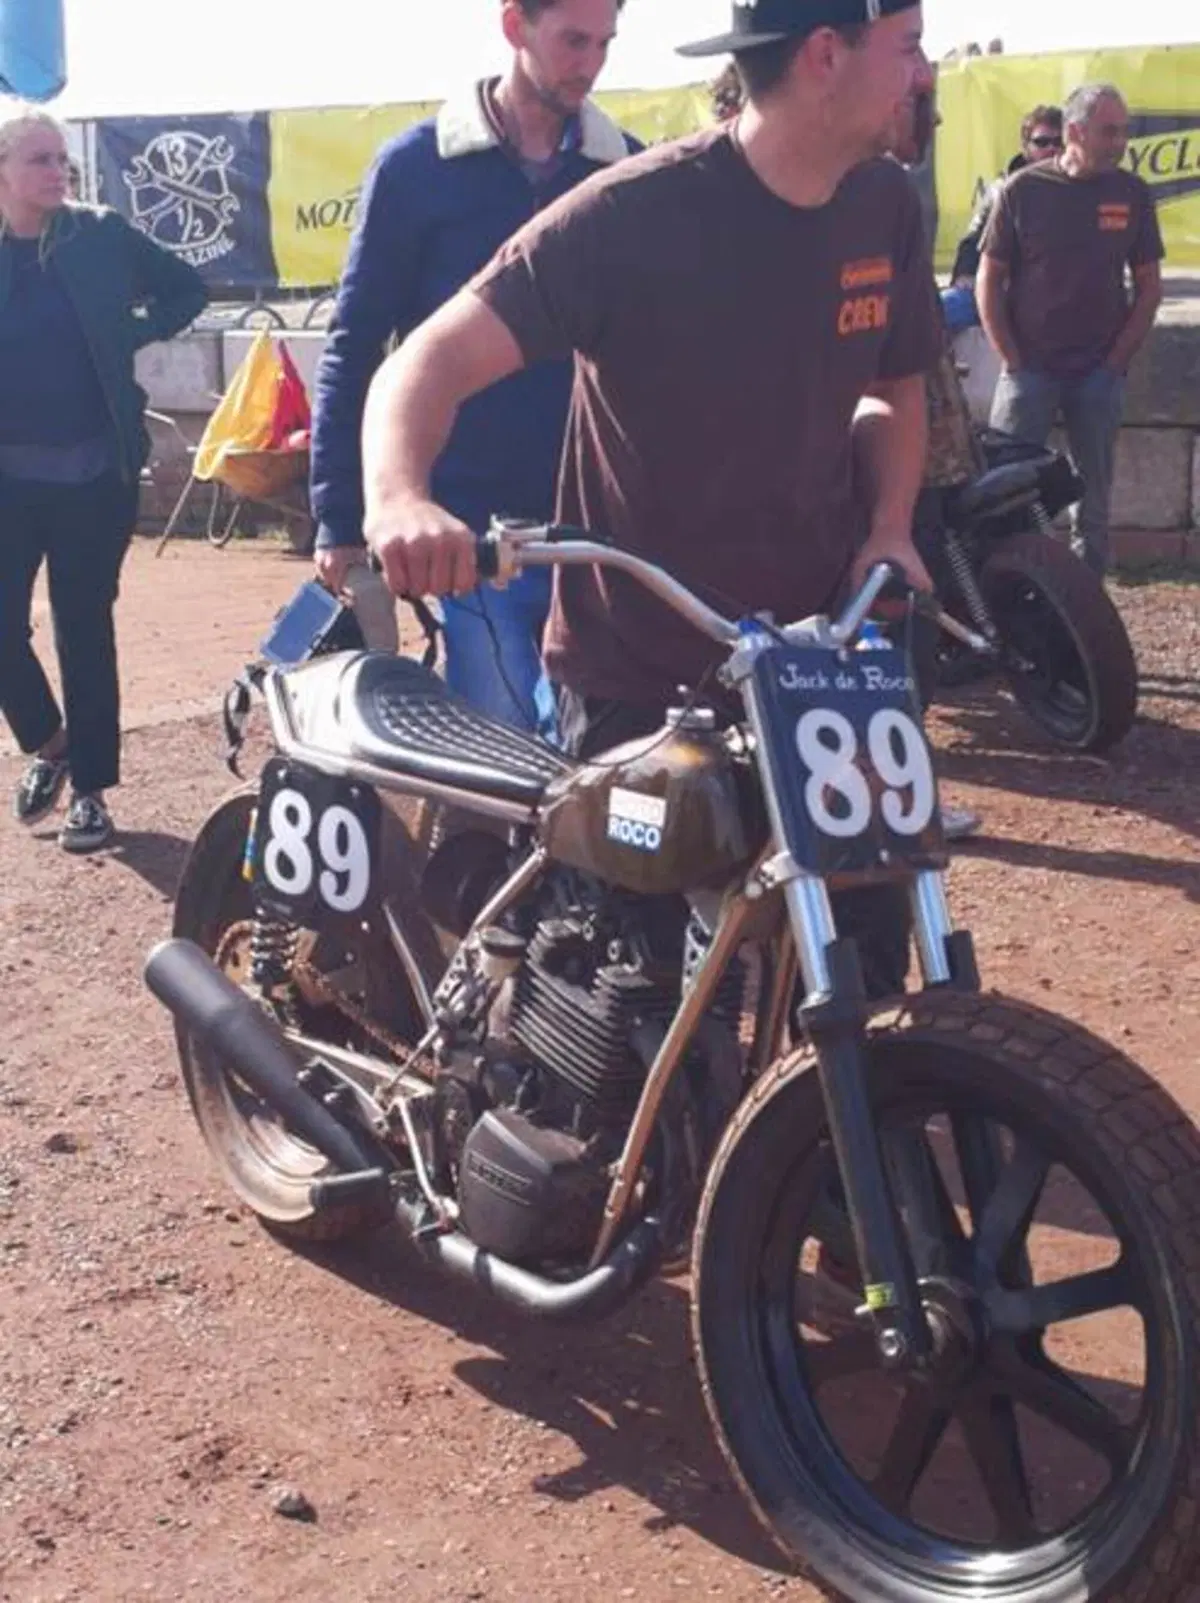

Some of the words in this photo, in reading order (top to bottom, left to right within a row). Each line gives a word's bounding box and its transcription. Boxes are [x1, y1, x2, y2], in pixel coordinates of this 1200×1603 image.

[157, 137, 187, 177] 13
[1129, 137, 1200, 175] YCL
[838, 296, 889, 334] CREW
[779, 664, 829, 689] Jack
[835, 671, 858, 690] de
[796, 708, 934, 837] 89
[264, 788, 370, 912] 89
[607, 815, 661, 850] ROCO
